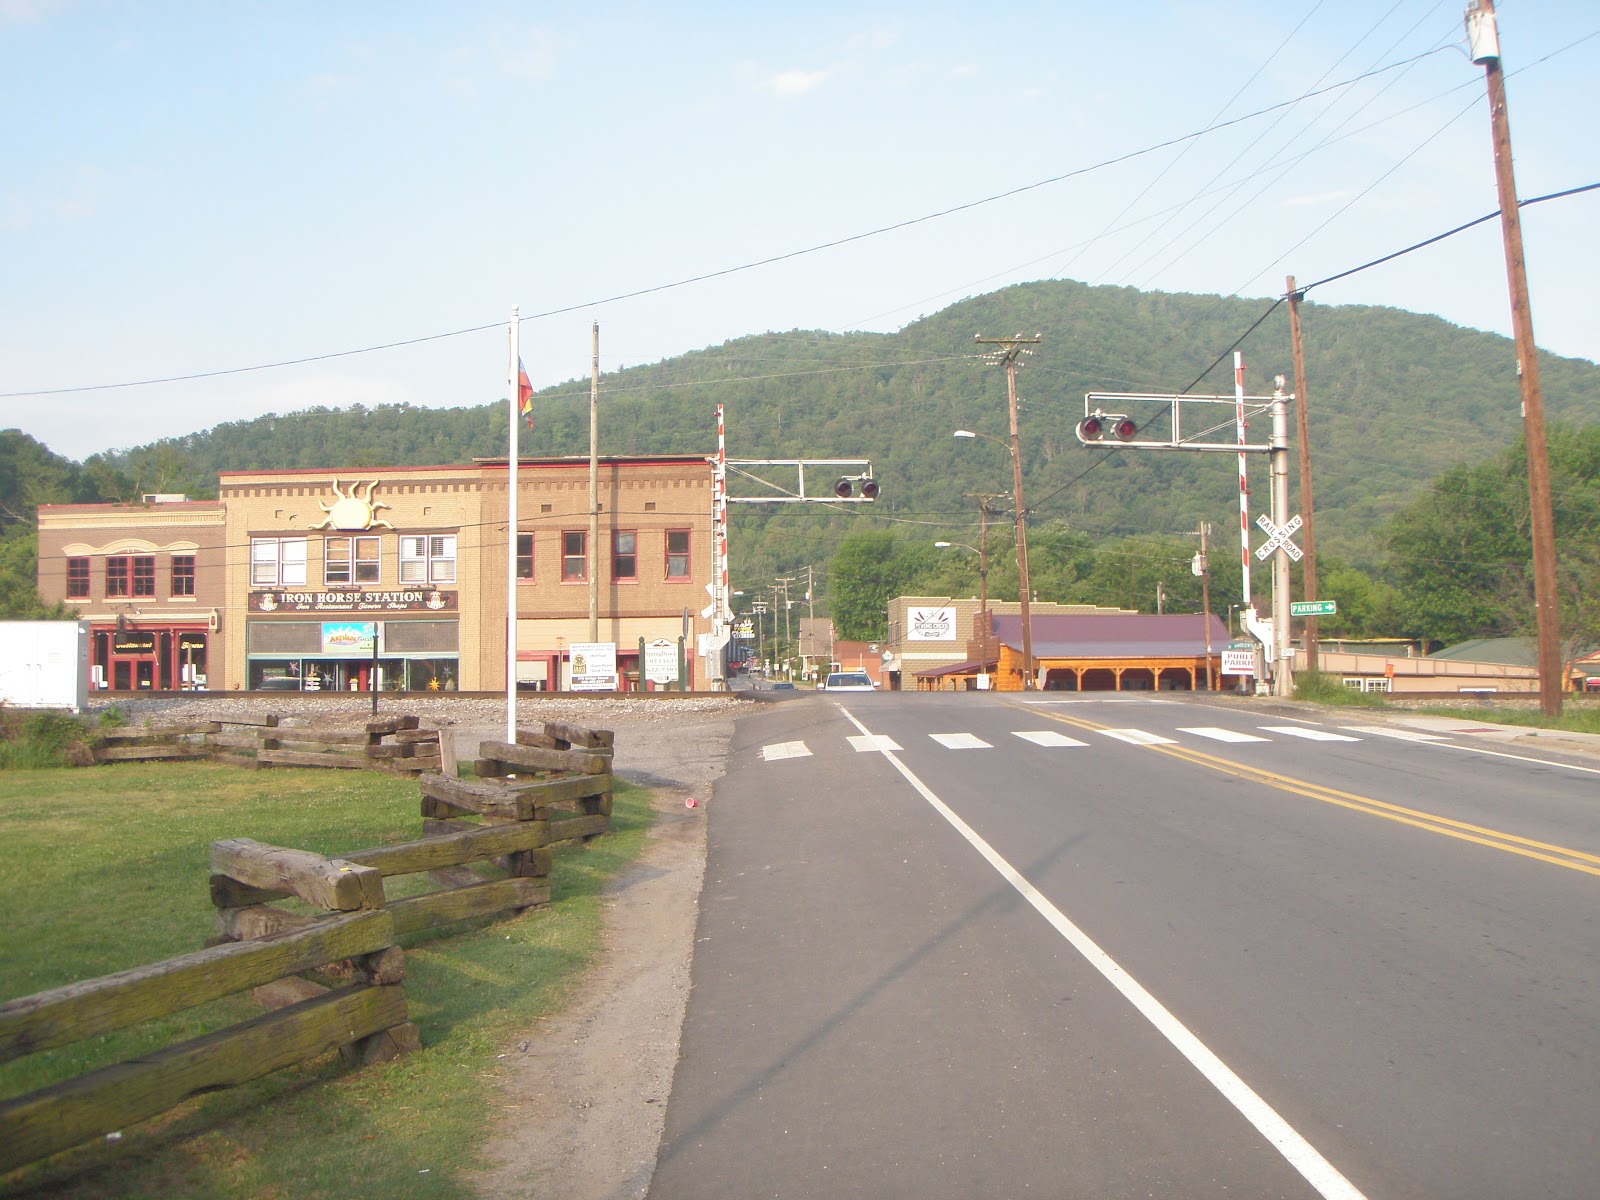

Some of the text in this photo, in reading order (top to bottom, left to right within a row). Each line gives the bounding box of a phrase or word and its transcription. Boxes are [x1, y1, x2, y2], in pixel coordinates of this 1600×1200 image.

[1257, 517, 1302, 558] CROSSING
[1258, 517, 1301, 559] RAIL ROAD
[281, 592, 423, 603] IRON HORSE STATION
[387, 602, 408, 610] Shops
[1292, 604, 1323, 613] PARKING
